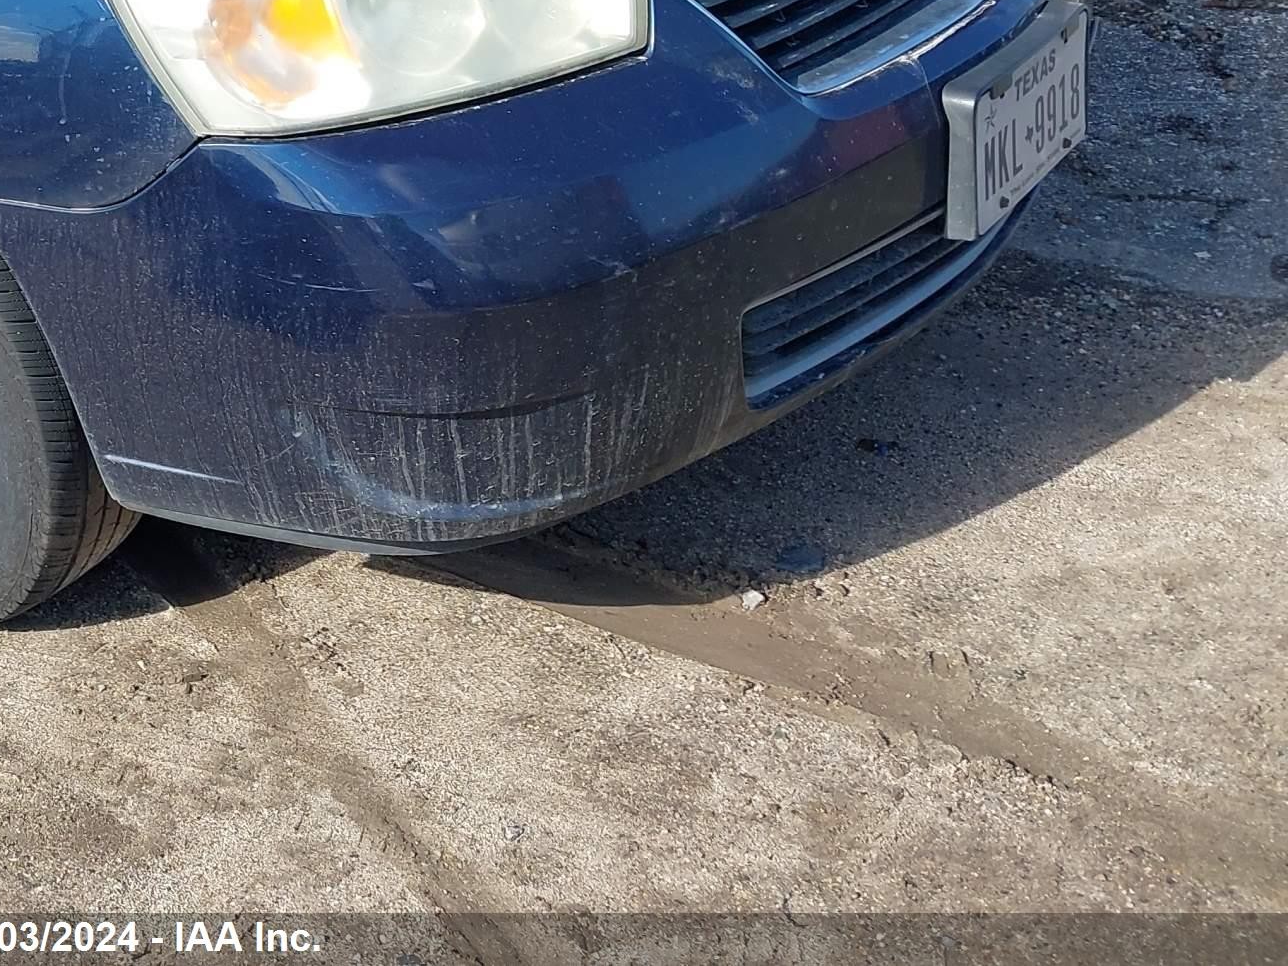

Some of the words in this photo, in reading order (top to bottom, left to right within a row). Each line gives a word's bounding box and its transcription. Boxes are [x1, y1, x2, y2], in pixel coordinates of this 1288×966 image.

[1014, 48, 1056, 102] TEXAS
[984, 117, 1024, 201] MKL
[1035, 63, 1081, 155] 9918
